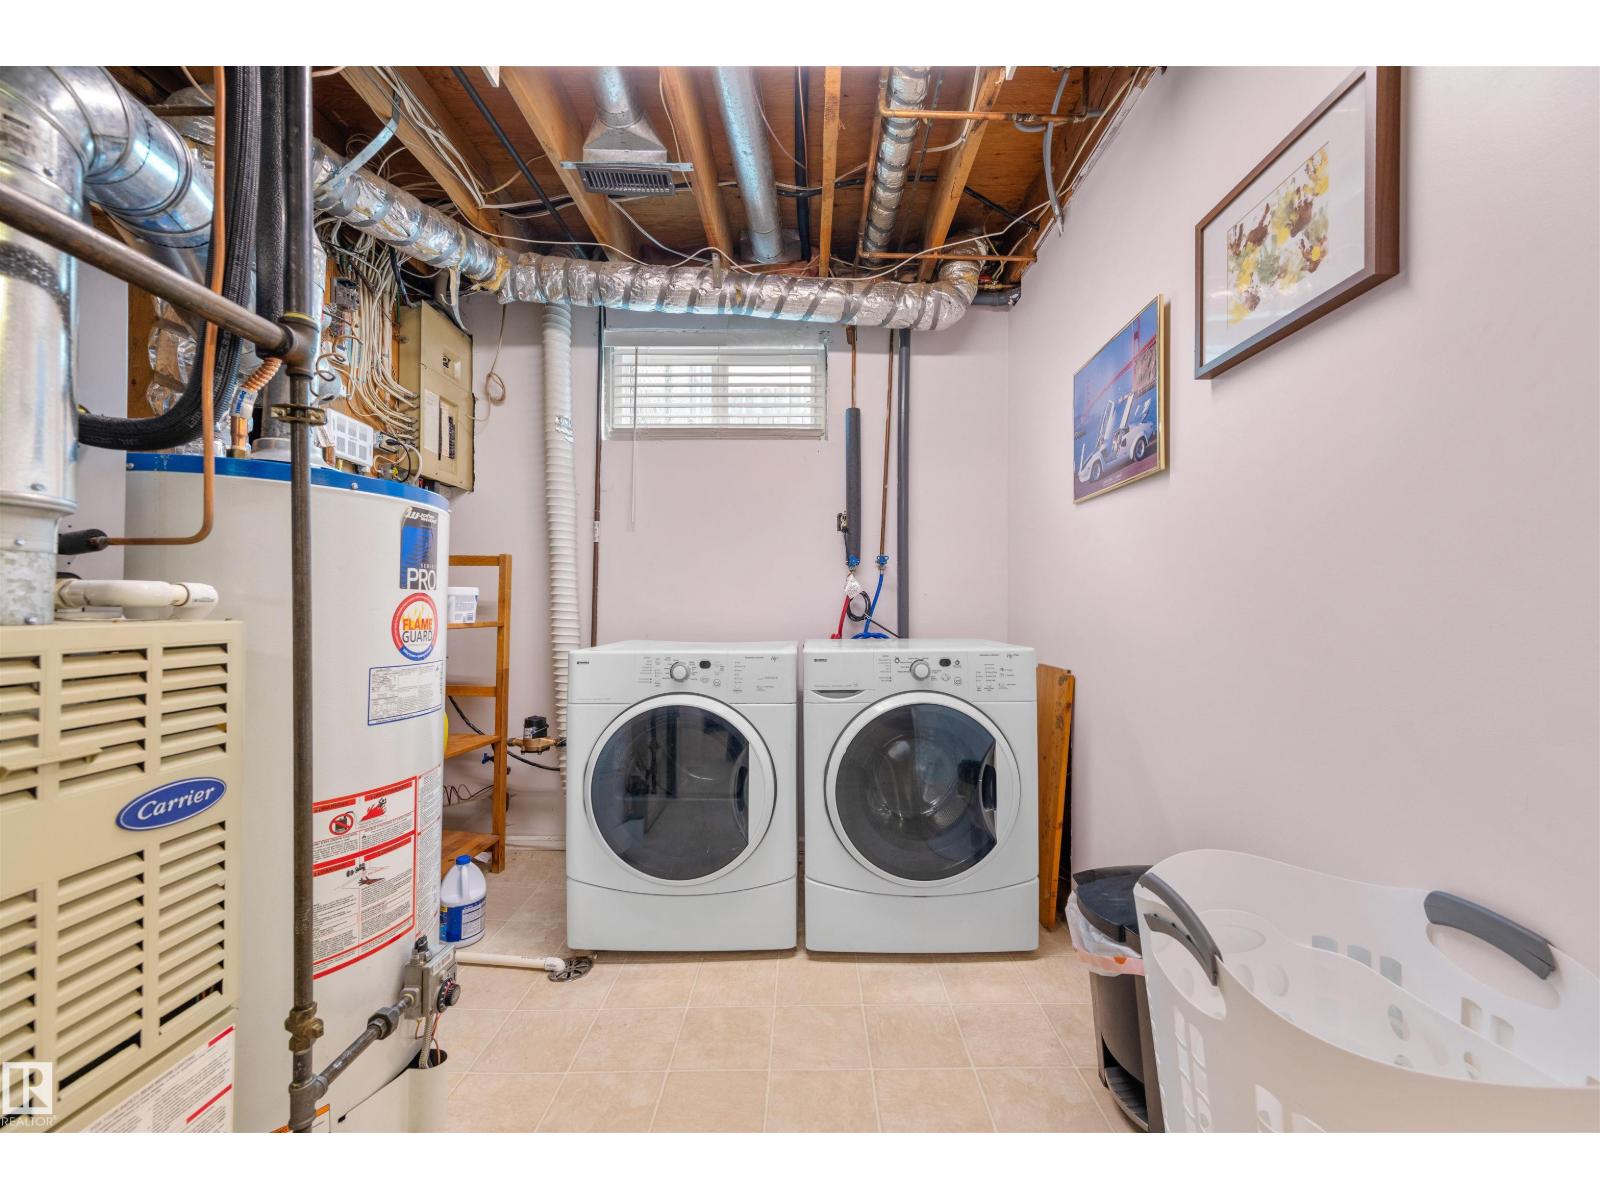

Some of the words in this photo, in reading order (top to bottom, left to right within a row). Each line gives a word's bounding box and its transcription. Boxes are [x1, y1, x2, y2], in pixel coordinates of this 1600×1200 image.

[407, 567, 436, 592] PRO
[402, 618, 432, 631] FLAME
[402, 630, 432, 643] GUARD
[136, 786, 215, 821] Carrier
